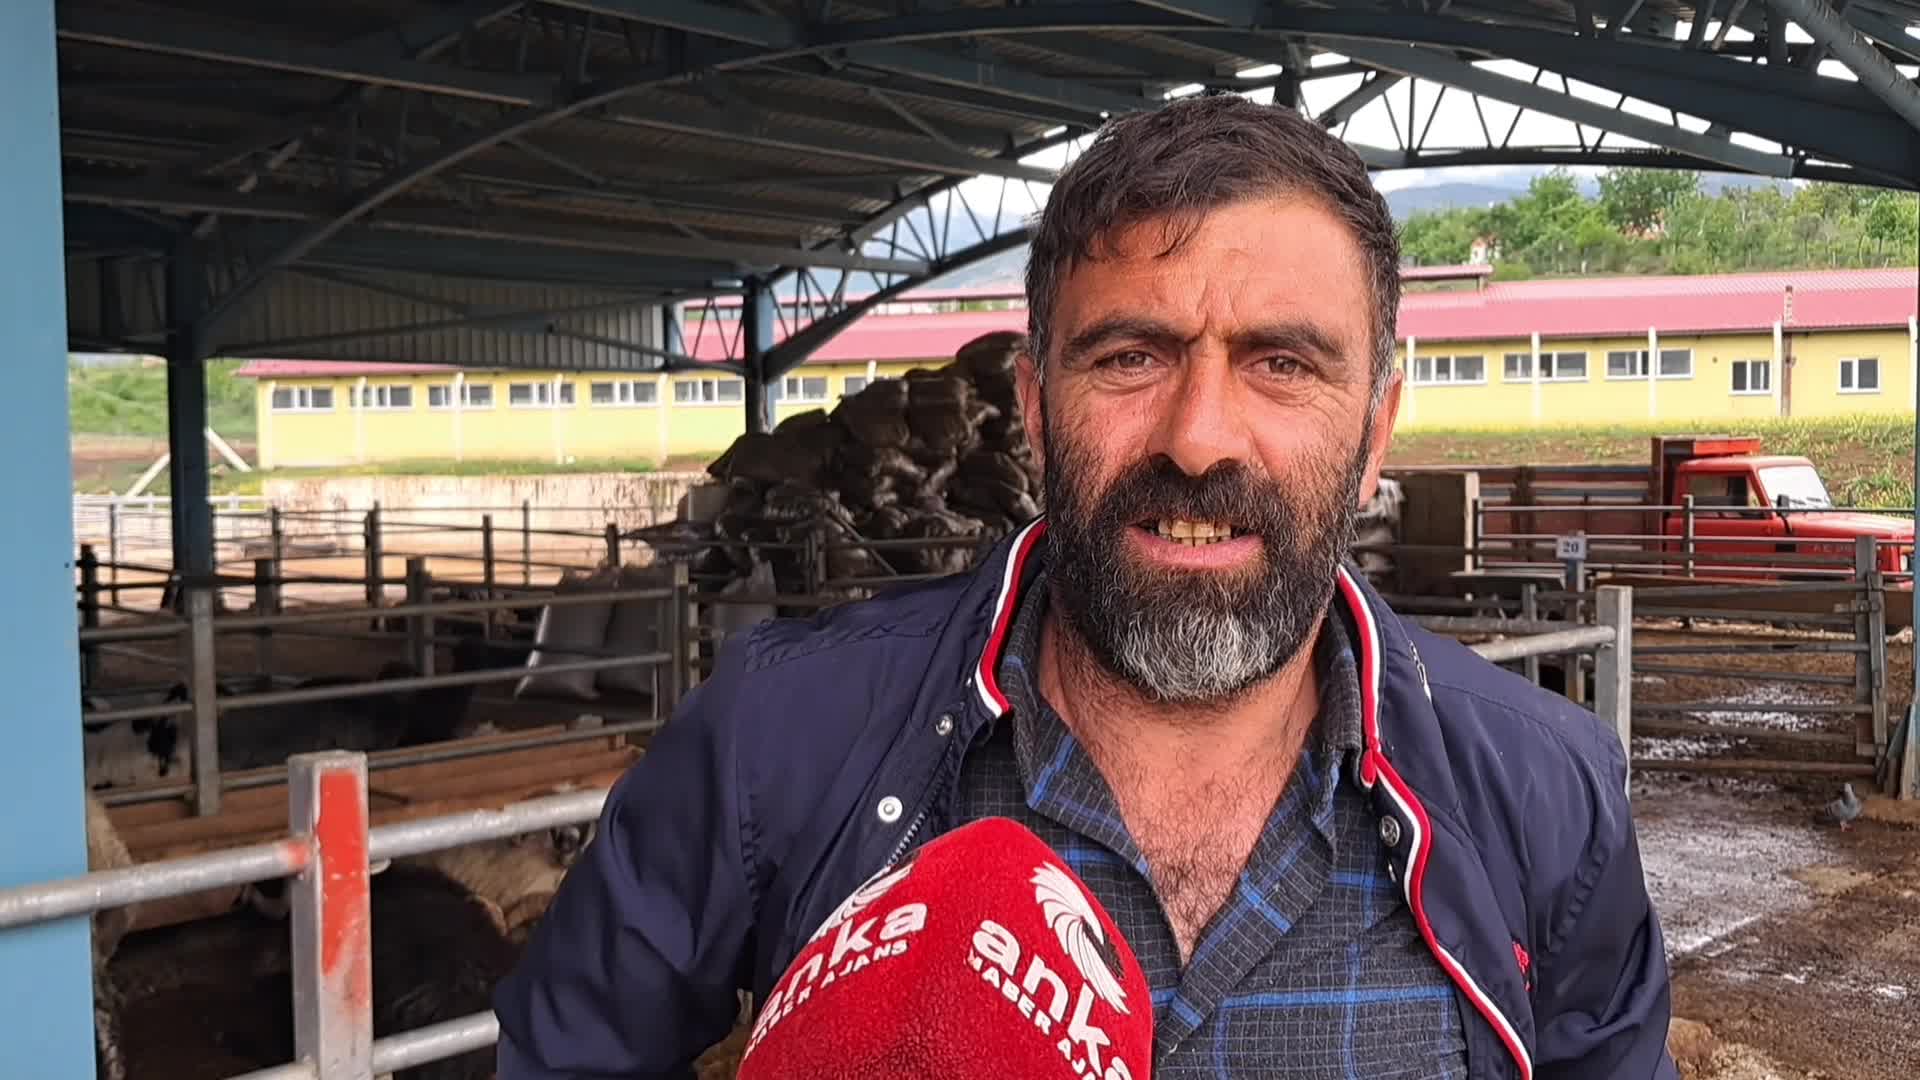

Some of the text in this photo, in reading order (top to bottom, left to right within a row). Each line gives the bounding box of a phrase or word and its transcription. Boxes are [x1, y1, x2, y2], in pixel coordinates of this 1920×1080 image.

[1563, 540, 1580, 553] 20
[752, 903, 927, 1039] anka
[820, 940, 908, 989] AJANS
[967, 948, 1096, 1080] HABER AJ
